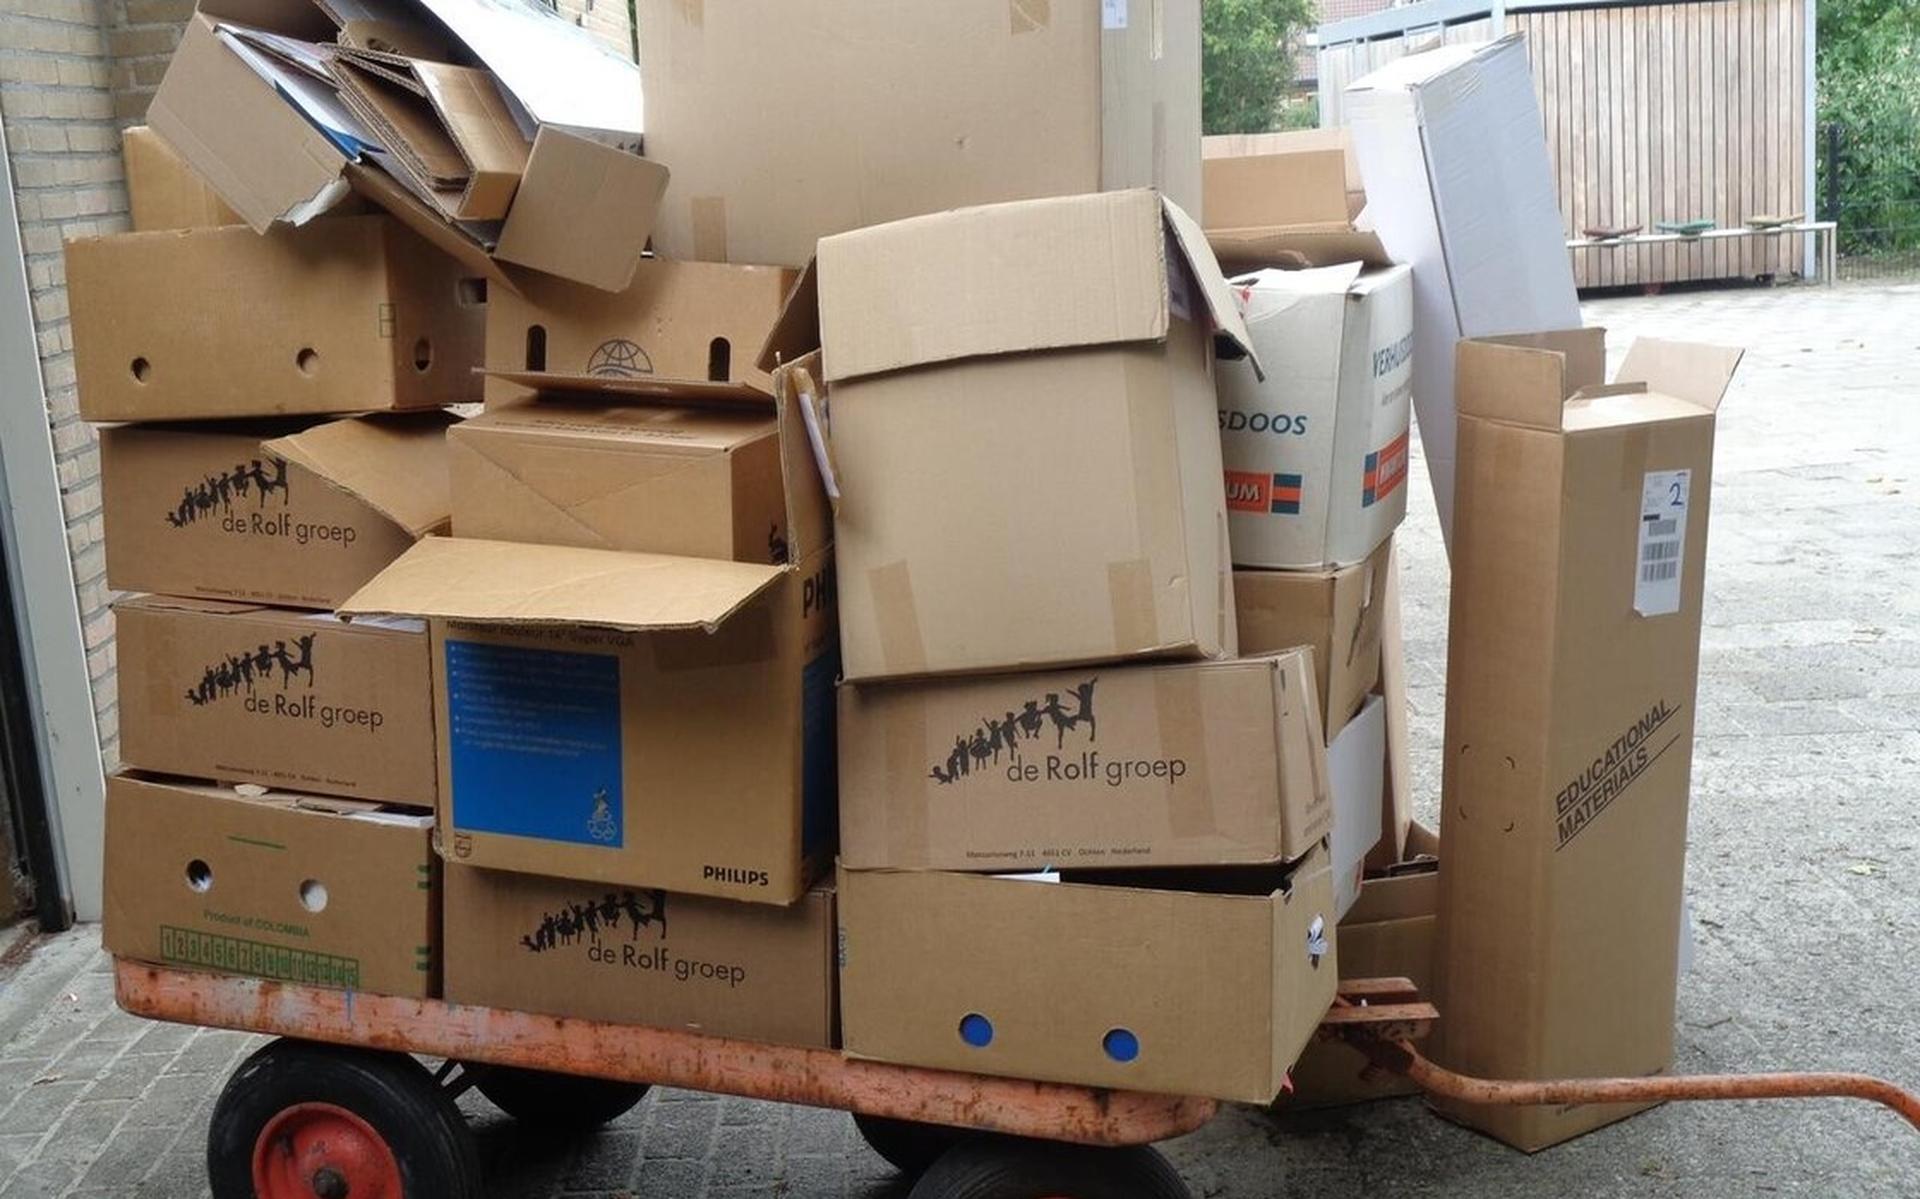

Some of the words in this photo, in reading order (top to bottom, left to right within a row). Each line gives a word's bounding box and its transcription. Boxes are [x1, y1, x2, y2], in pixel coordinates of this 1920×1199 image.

[1669, 482, 1684, 506] 2
[222, 510, 247, 533] de
[251, 513, 291, 536] Rolf
[296, 523, 356, 548] groep
[244, 689, 270, 713] de
[275, 694, 317, 719] Rolf
[321, 706, 383, 732] groep
[1007, 754, 1039, 782] de
[1047, 751, 1099, 781] Rolf
[1106, 759, 1187, 787] groep
[1556, 699, 1671, 815] EDUCATIONAL
[1557, 747, 1649, 843] MATERIALS
[703, 865, 769, 887] PHILIPS
[255, 919, 311, 937] COLOMBIA
[588, 939, 616, 964] de
[623, 944, 669, 971] Rolf
[674, 958, 745, 988] groep
